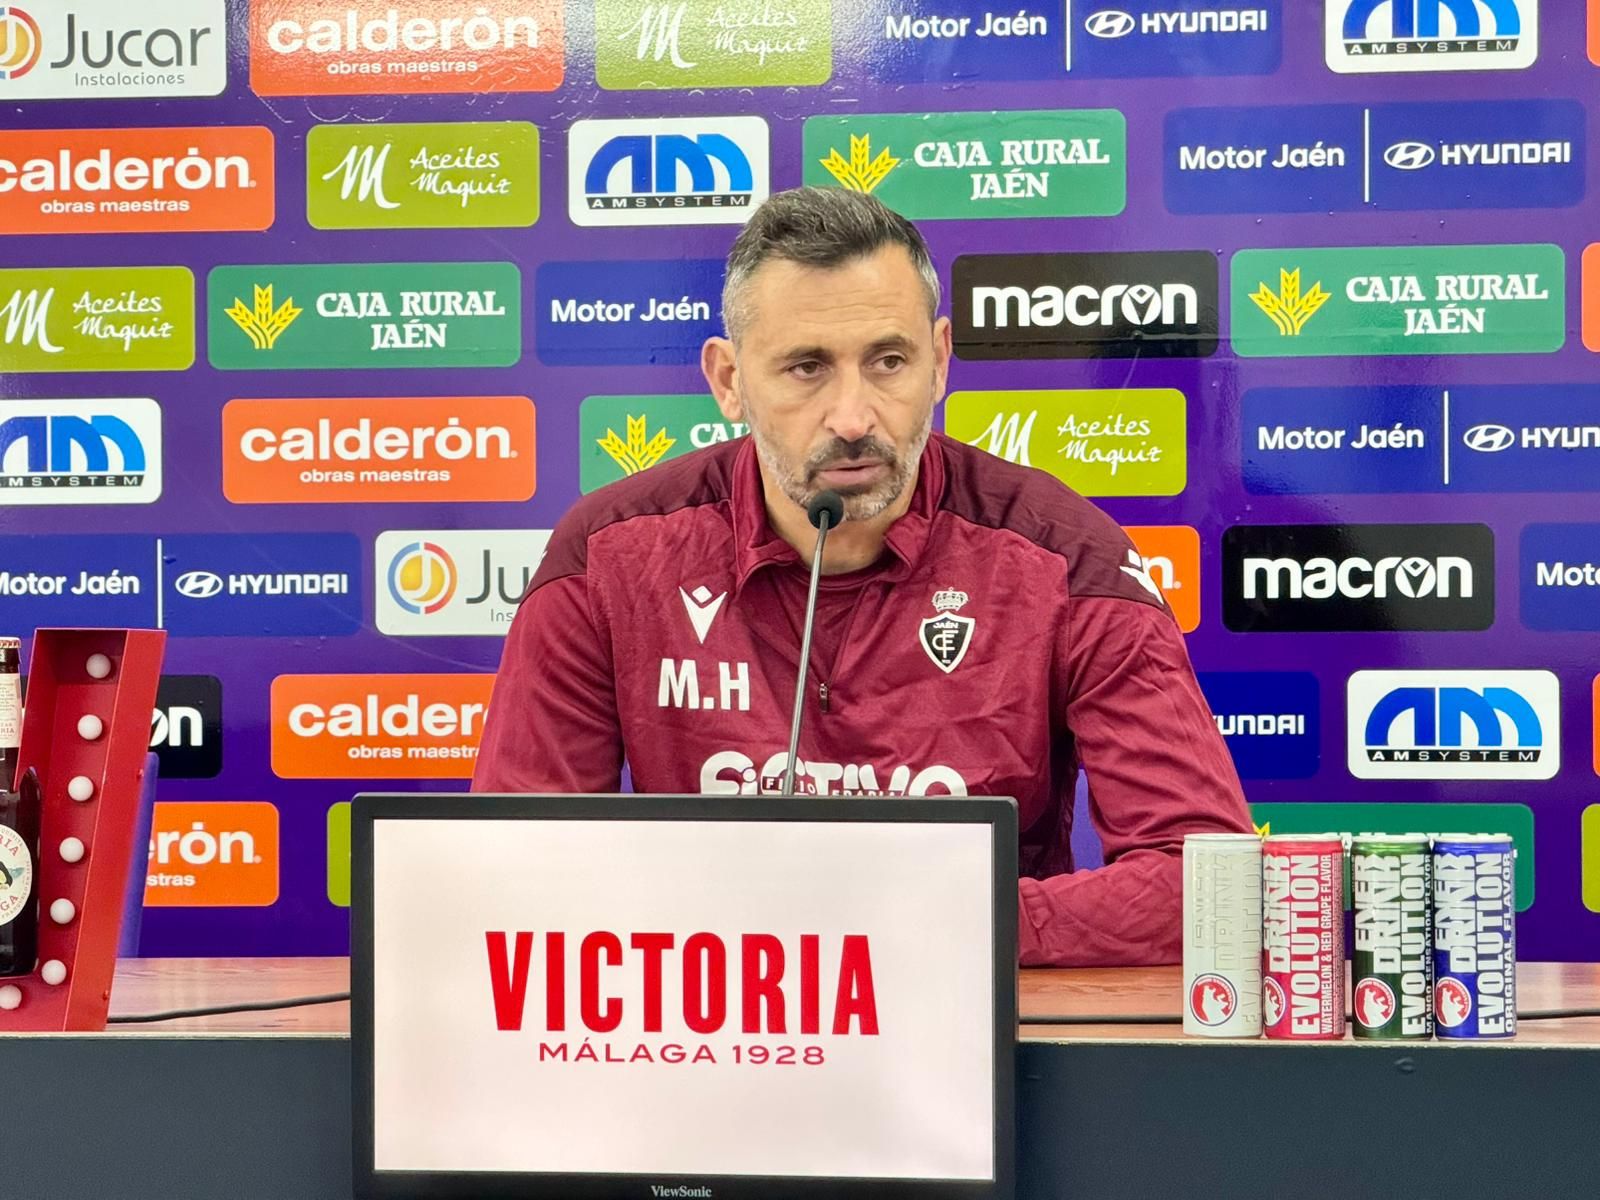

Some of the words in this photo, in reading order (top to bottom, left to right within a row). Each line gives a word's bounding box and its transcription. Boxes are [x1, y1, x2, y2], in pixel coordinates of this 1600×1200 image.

[708, 3, 798, 30] Aceites
[885, 14, 972, 39] Motor
[975, 8, 1047, 37] Jaén
[1140, 10, 1267, 34] HYUNDAI
[50, 13, 212, 69] Jucar
[74, 72, 186, 87] Instalaciones
[327, 61, 382, 75] obras
[387, 59, 478, 74] maestras
[410, 146, 501, 171] Aceites
[914, 142, 991, 169] CAJA
[1001, 139, 1110, 166] RURAL
[1179, 145, 1266, 171] Motor
[1272, 141, 1345, 169] Jaén
[1441, 142, 1571, 166] HYUNDAI
[411, 171, 512, 207] Maquiz
[970, 168, 1049, 200] JAÉN
[40, 200, 95, 214] obras
[100, 198, 190, 213] maestras
[72, 290, 163, 314] Aceites
[1345, 275, 1426, 304] CAJA
[1435, 273, 1549, 301] RURAL
[315, 290, 392, 319] CAJA
[400, 289, 506, 317] RURAL
[550, 299, 636, 324] Motor
[639, 295, 710, 322] Jaén
[971, 282, 1198, 329] macron
[74, 315, 175, 352] Maquiz
[370, 319, 447, 350] JAÉN
[1403, 304, 1486, 336] JAÉN
[689, 422, 748, 449] CAJ
[1057, 414, 1151, 438] Aceites
[1258, 427, 1345, 451] Motor
[1350, 422, 1425, 449] Jaén
[1521, 427, 1600, 452] HYUN
[1057, 440, 1163, 475] Maquiz
[0, 475, 140, 487] MSYSTEM
[299, 468, 355, 483] obras
[359, 466, 451, 482] maestras
[71, 569, 140, 595] Jaén
[229, 573, 348, 595] HYUNDAI
[1243, 555, 1473, 599] macron
[658, 658, 751, 712] M.H
[288, 693, 489, 738] calder
[1212, 714, 1305, 735] UNDAI
[348, 744, 402, 758] obras
[407, 744, 480, 758] maestr
[146, 872, 196, 887] stras
[1321, 854, 1333, 893] FLAVOR
[1425, 854, 1433, 905] FLAVOR
[1504, 853, 1513, 931] FLAVOR
[1321, 895, 1333, 929] GRAPE
[1372, 855, 1401, 973] DRINK
[1450, 854, 1477, 973] DRINK
[1291, 855, 1321, 1035] EVOLUTION
[1321, 930, 1333, 951] RED
[1401, 853, 1426, 1035] EVOLUTION
[1425, 908, 1433, 981] SENSATION
[1476, 853, 1504, 1035] EVOLUTION
[1321, 953, 1333, 962] &
[485, 931, 880, 1036] VICTORIA
[1504, 937, 1513, 1033] ORIGINAL
[1321, 964, 1333, 1034] WATERMELON
[1425, 985, 1433, 1034] MANGO
[539, 1037, 717, 1064] MÁLAGA
[732, 1044, 826, 1066] 1928
[650, 1185, 713, 1198] ViewSonic
